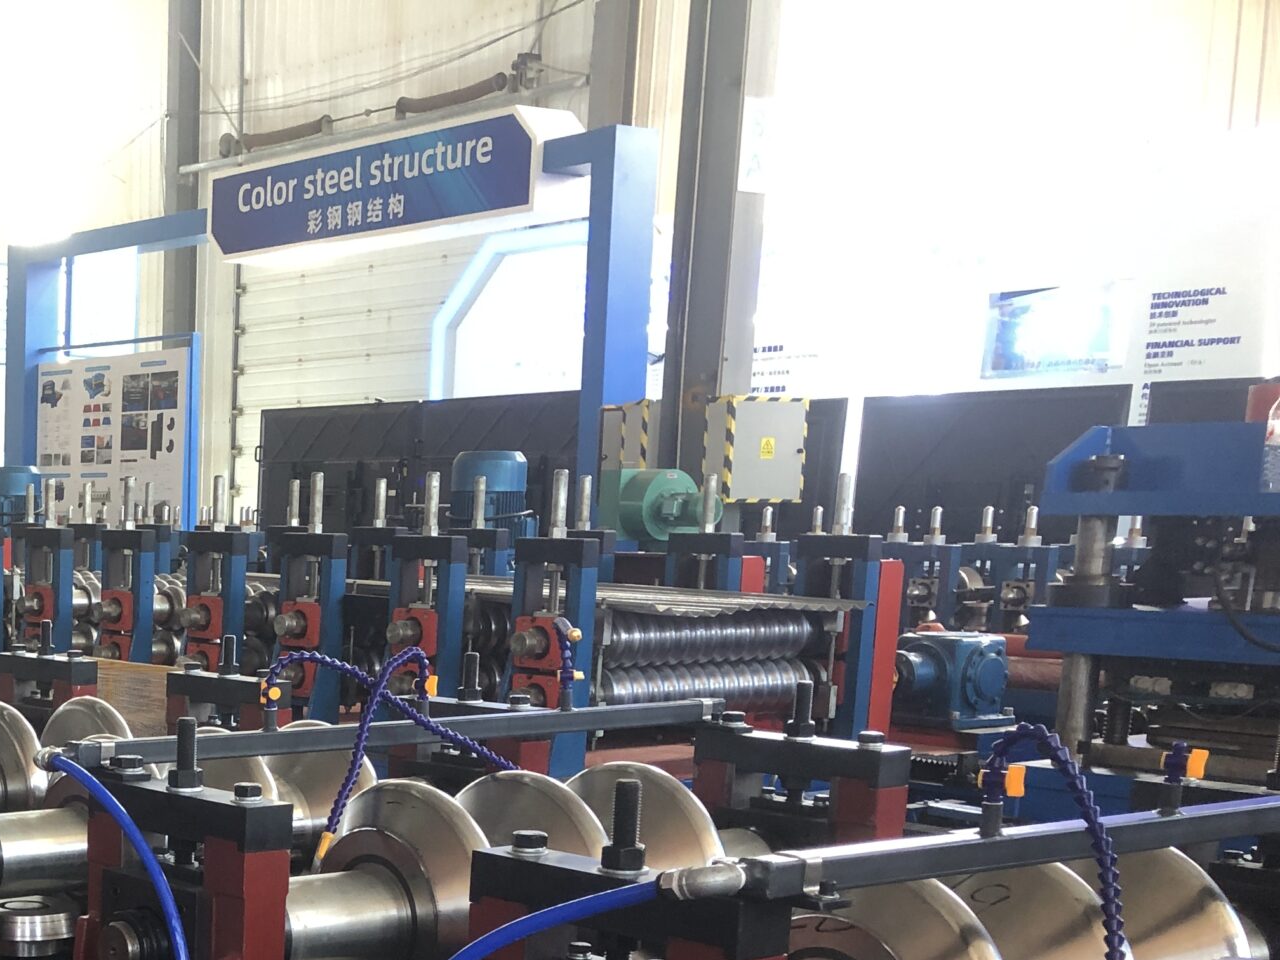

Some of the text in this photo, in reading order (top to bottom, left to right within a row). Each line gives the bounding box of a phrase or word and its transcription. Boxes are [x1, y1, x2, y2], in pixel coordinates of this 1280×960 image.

[237, 136, 494, 213] Color steel structure
[306, 193, 406, 235] 彩钢钢结构
[1152, 287, 1228, 301] TECHNOLOGICAL
[1150, 298, 1210, 310] INNOVATION
[1145, 336, 1242, 350] FINANCIAL SUPPORT
